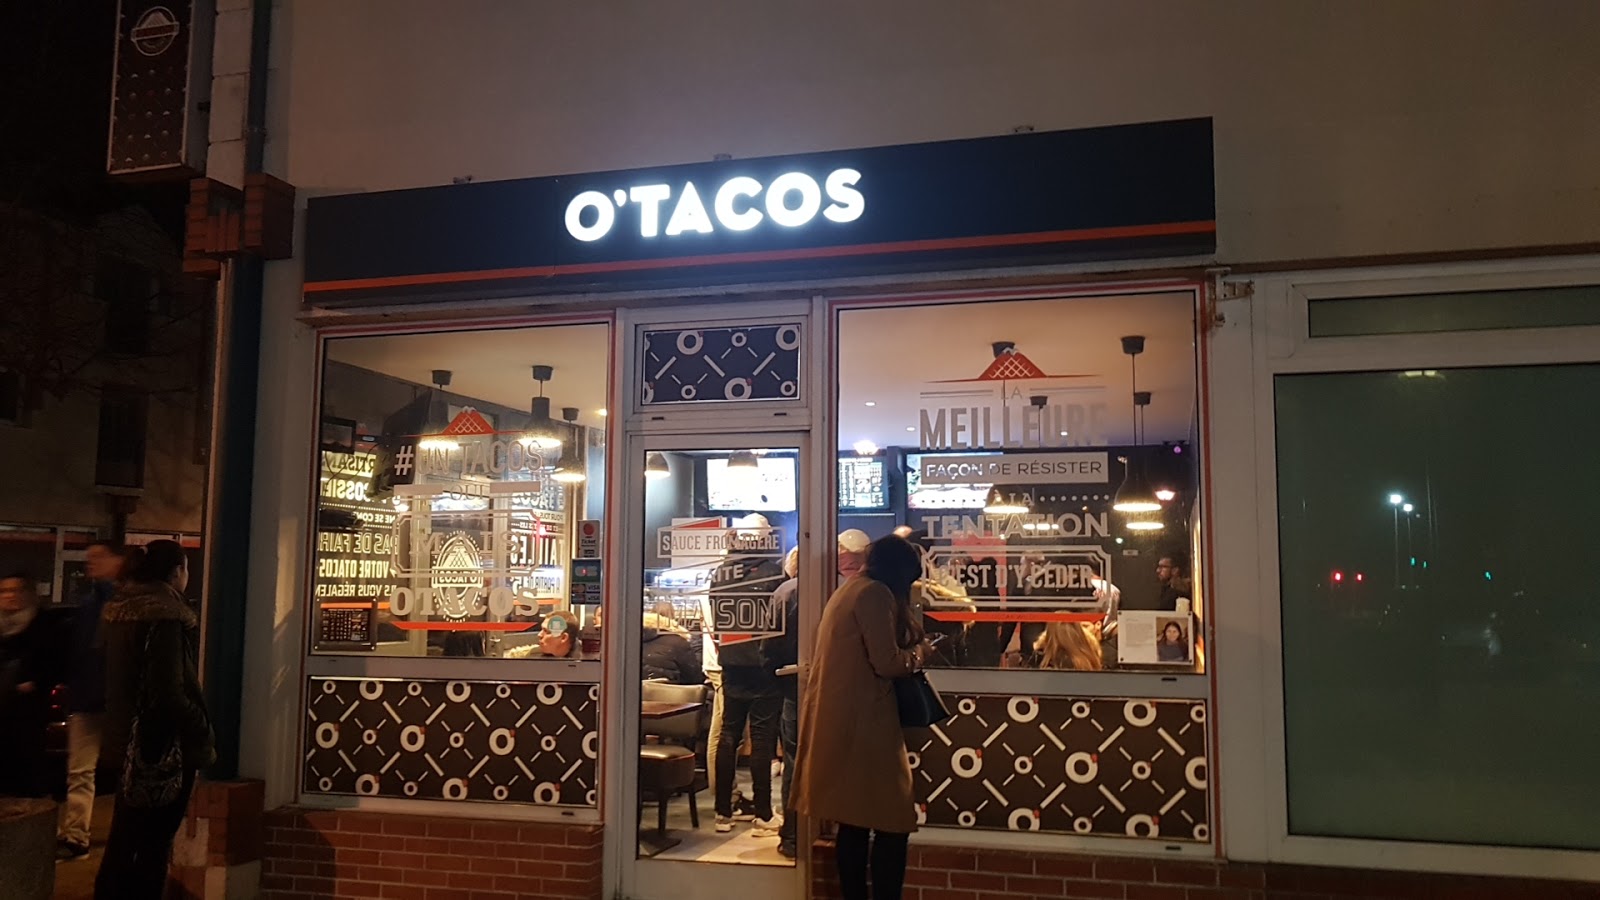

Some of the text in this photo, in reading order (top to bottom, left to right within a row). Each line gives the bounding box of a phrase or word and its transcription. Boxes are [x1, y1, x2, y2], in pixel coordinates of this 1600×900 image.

[564, 167, 866, 242] O'TACOS
[1000, 386, 1023, 400] LA
[919, 402, 1109, 450] MEILLEURE
[458, 440, 543, 475] TACOS
[926, 459, 1102, 480] FAÇON DE RÉSISTER
[921, 512, 1110, 539] TENTATION
[662, 535, 701, 551] SAUCE
[695, 564, 744, 586] FAITE
